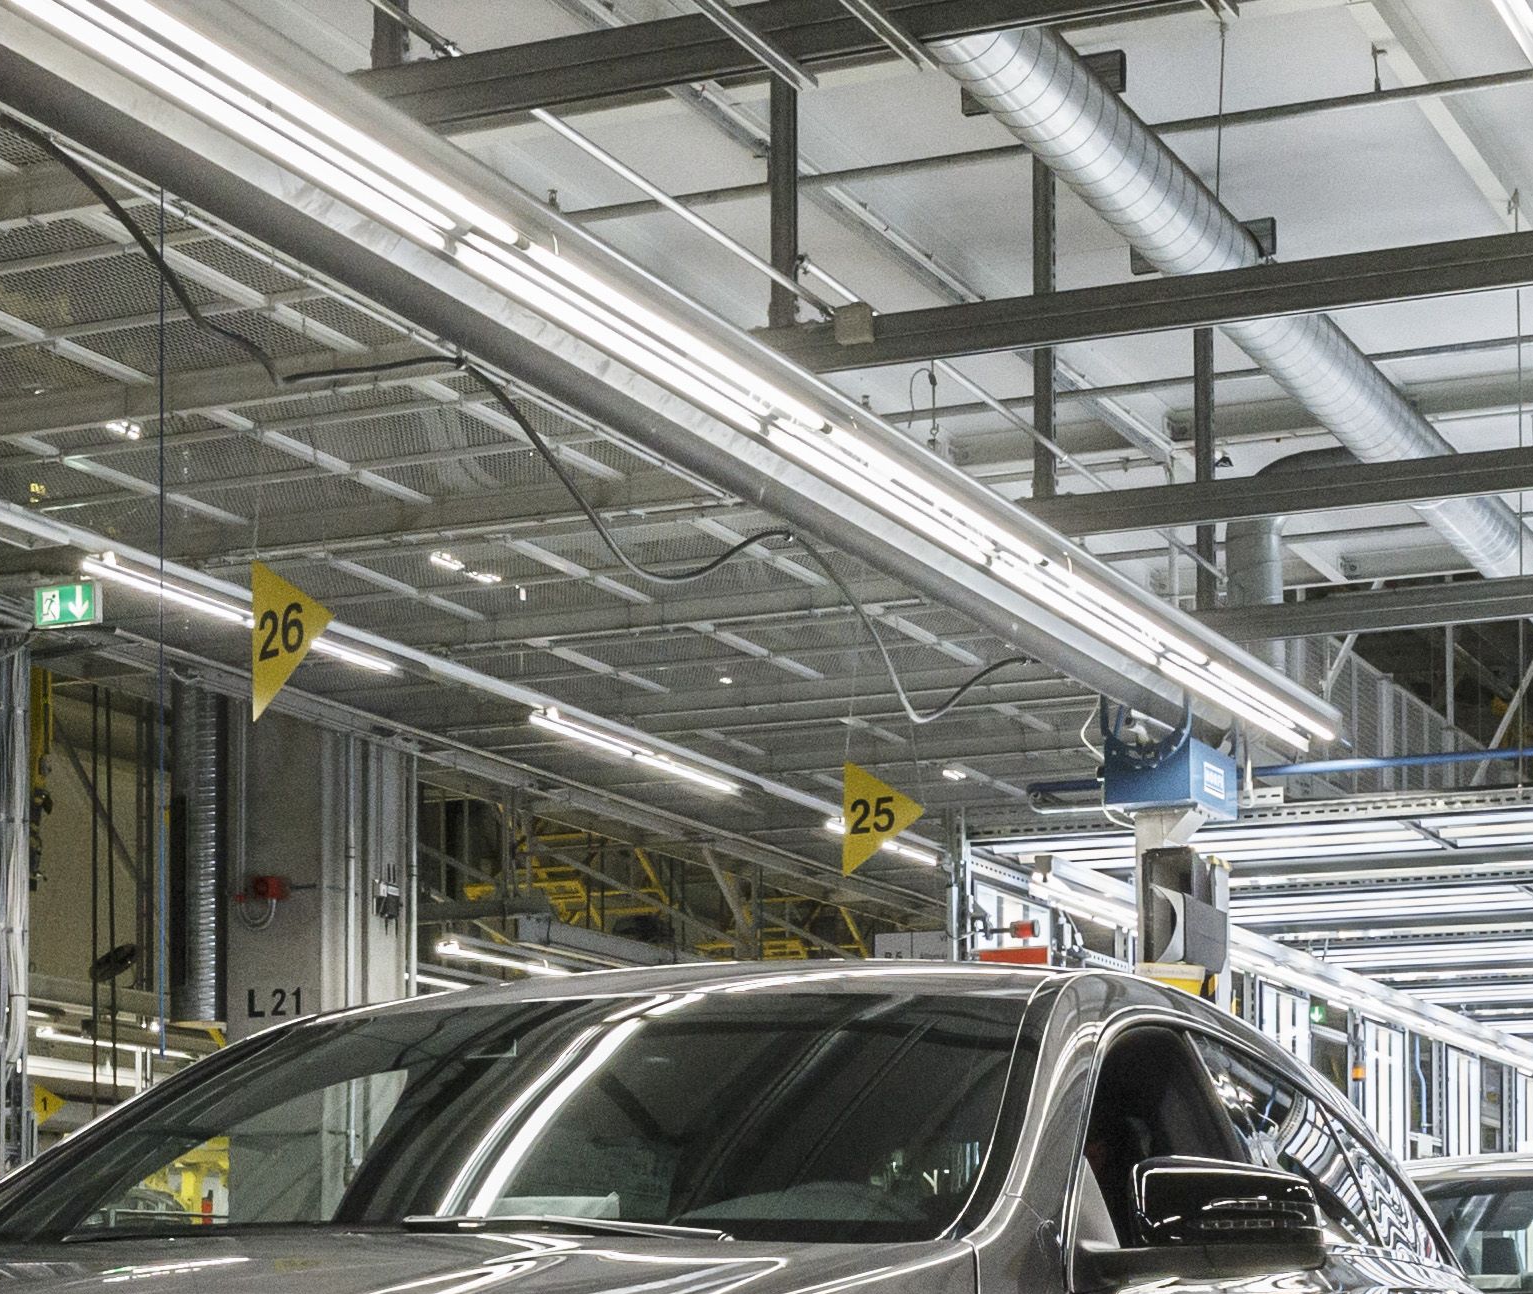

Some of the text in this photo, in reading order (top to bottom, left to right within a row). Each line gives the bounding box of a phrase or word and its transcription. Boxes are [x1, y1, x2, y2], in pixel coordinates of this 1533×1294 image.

[259, 602, 304, 662] 26
[850, 796, 895, 835] 25
[41, 1096, 48, 1112] 1
